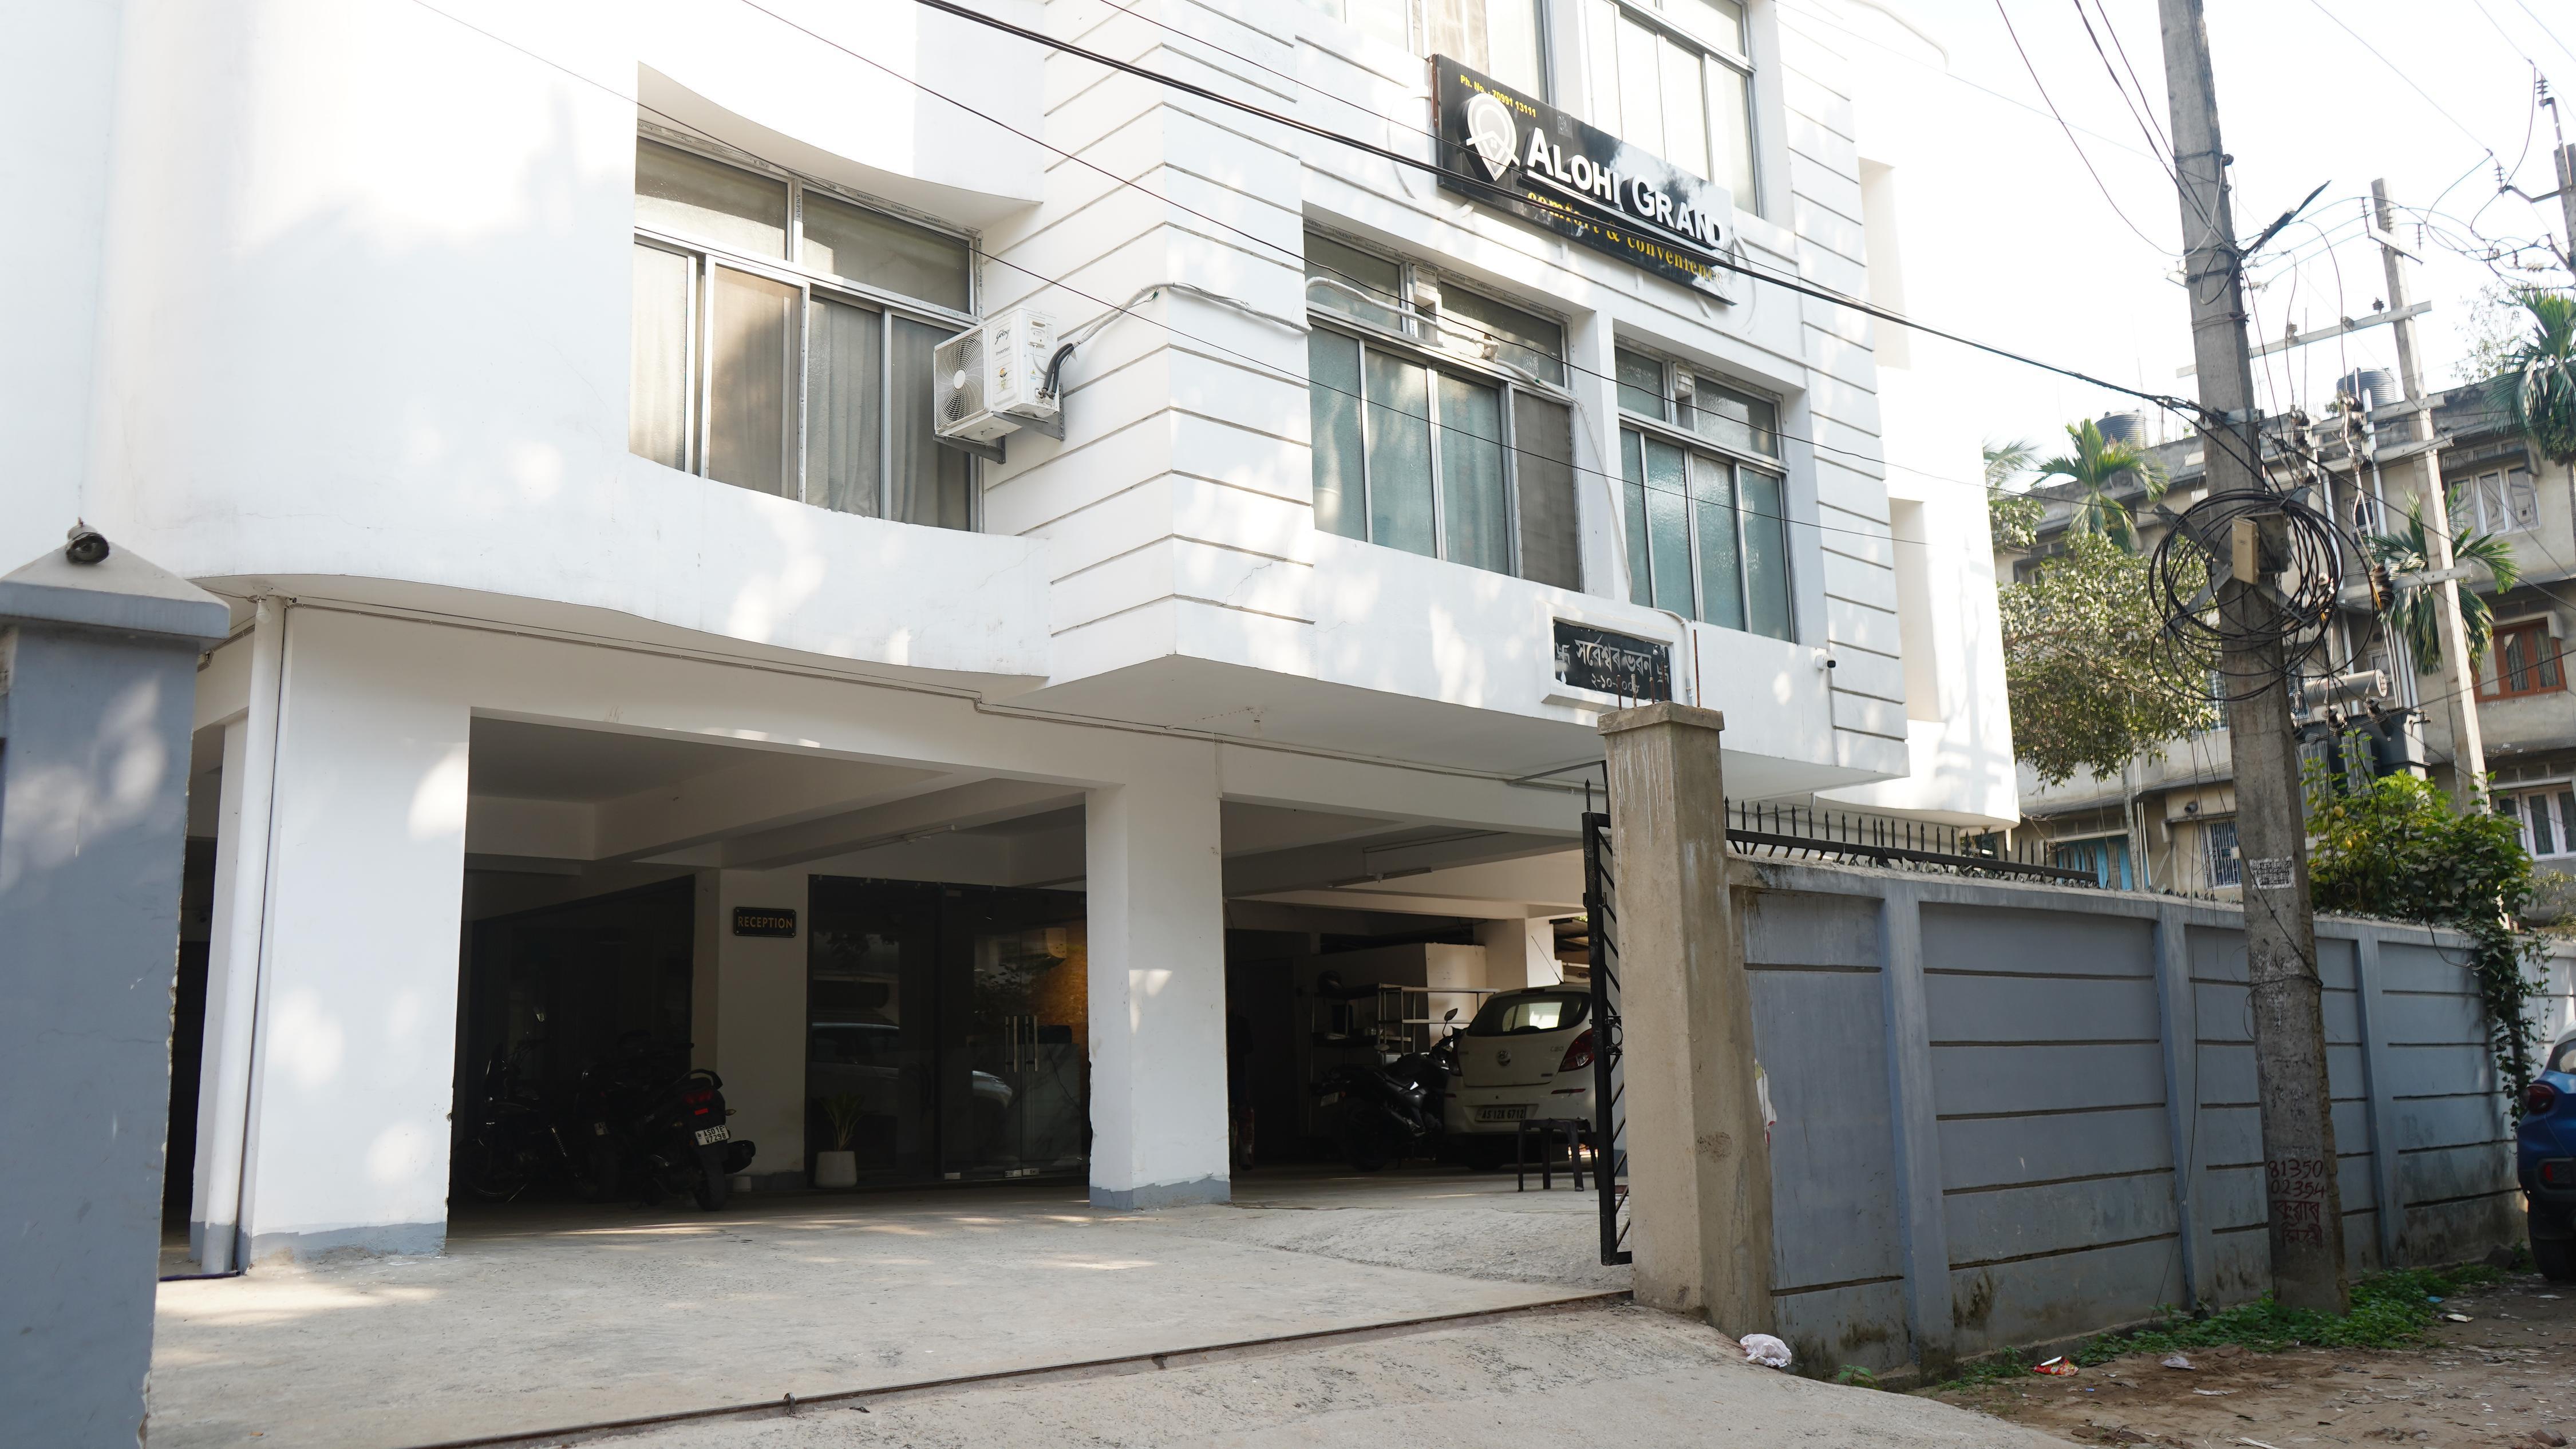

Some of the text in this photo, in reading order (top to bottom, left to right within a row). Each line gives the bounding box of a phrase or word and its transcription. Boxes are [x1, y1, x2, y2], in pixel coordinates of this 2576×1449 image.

[1492, 89, 1513, 108] 70991
[1515, 101, 1536, 118] 13111
[1527, 127, 1725, 250] ALOHI GRAND
[1627, 236, 1723, 284] convenience
[738, 916, 793, 928] RECEPTION
[2267, 1158, 2324, 1179] 81350
[2270, 1179, 2326, 1199] 02354
